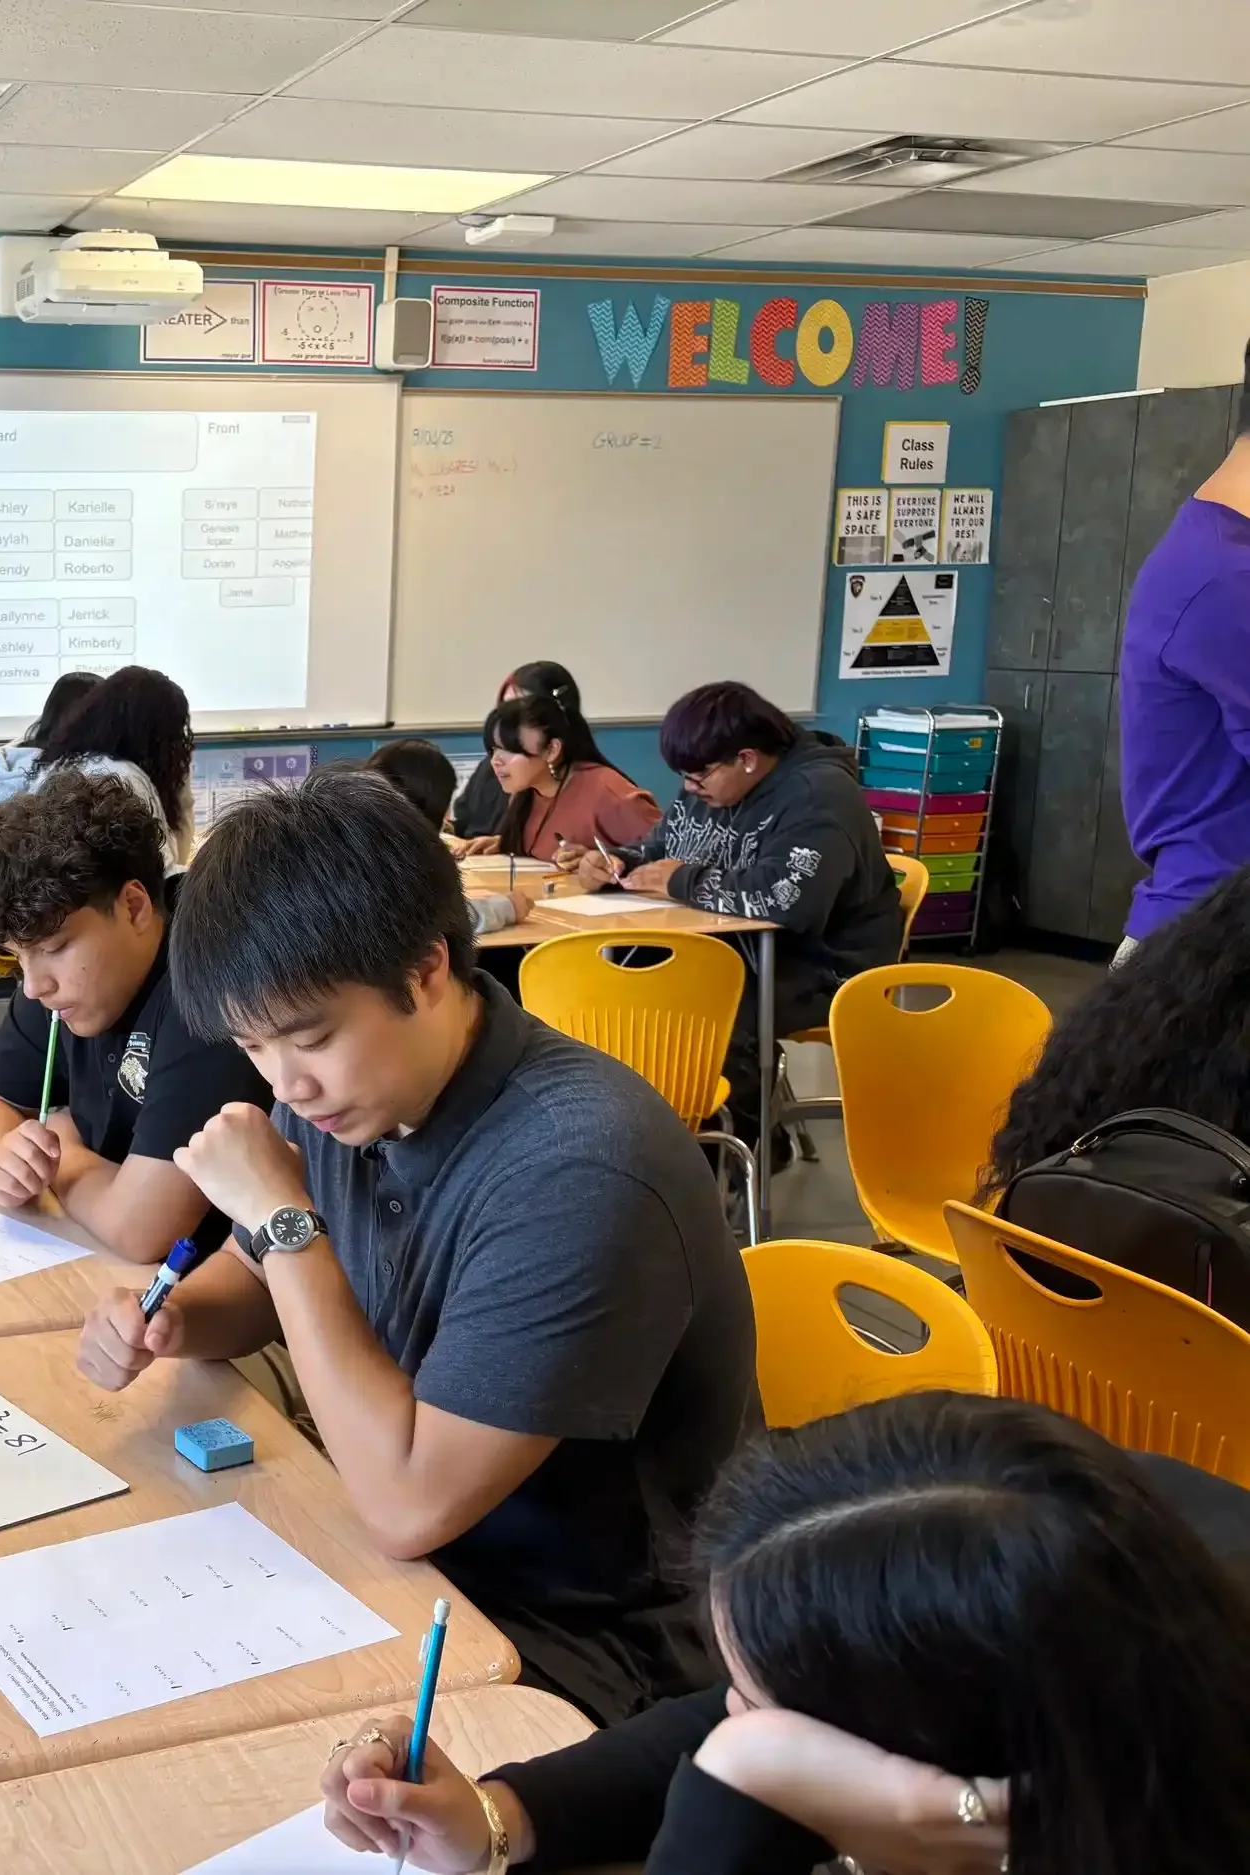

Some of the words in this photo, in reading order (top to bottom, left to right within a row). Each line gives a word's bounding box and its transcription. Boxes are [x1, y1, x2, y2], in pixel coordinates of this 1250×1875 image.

[437, 296, 489, 307] Composite
[492, 298, 534, 308] Function
[231, 317, 250, 325] than
[588, 293, 989, 395] WELCOME!
[208, 422, 240, 435] Front
[902, 438, 935, 452] Class
[900, 457, 933, 471] Rules
[847, 496, 870, 506] THIS
[872, 496, 882, 506] IS
[897, 497, 937, 506] EVERYONE
[954, 494, 965, 503] WE
[968, 494, 985, 503] WILL
[846, 510, 852, 520] A
[856, 510, 881, 521] SAFE
[897, 508, 935, 517] SUPPORTS
[953, 506, 985, 515] ALWAYS
[894, 519, 936, 528] EVERYONE.
[951, 518, 965, 527] TRY
[969, 518, 985, 527] OUR
[844, 525, 880, 535] SPACE.
[955, 529, 977, 539] BEST.
[64, 536, 115, 548] Daniella
[64, 563, 114, 575] Roberto
[68, 609, 110, 620] Jerrick
[68, 637, 122, 649] Kimberly
